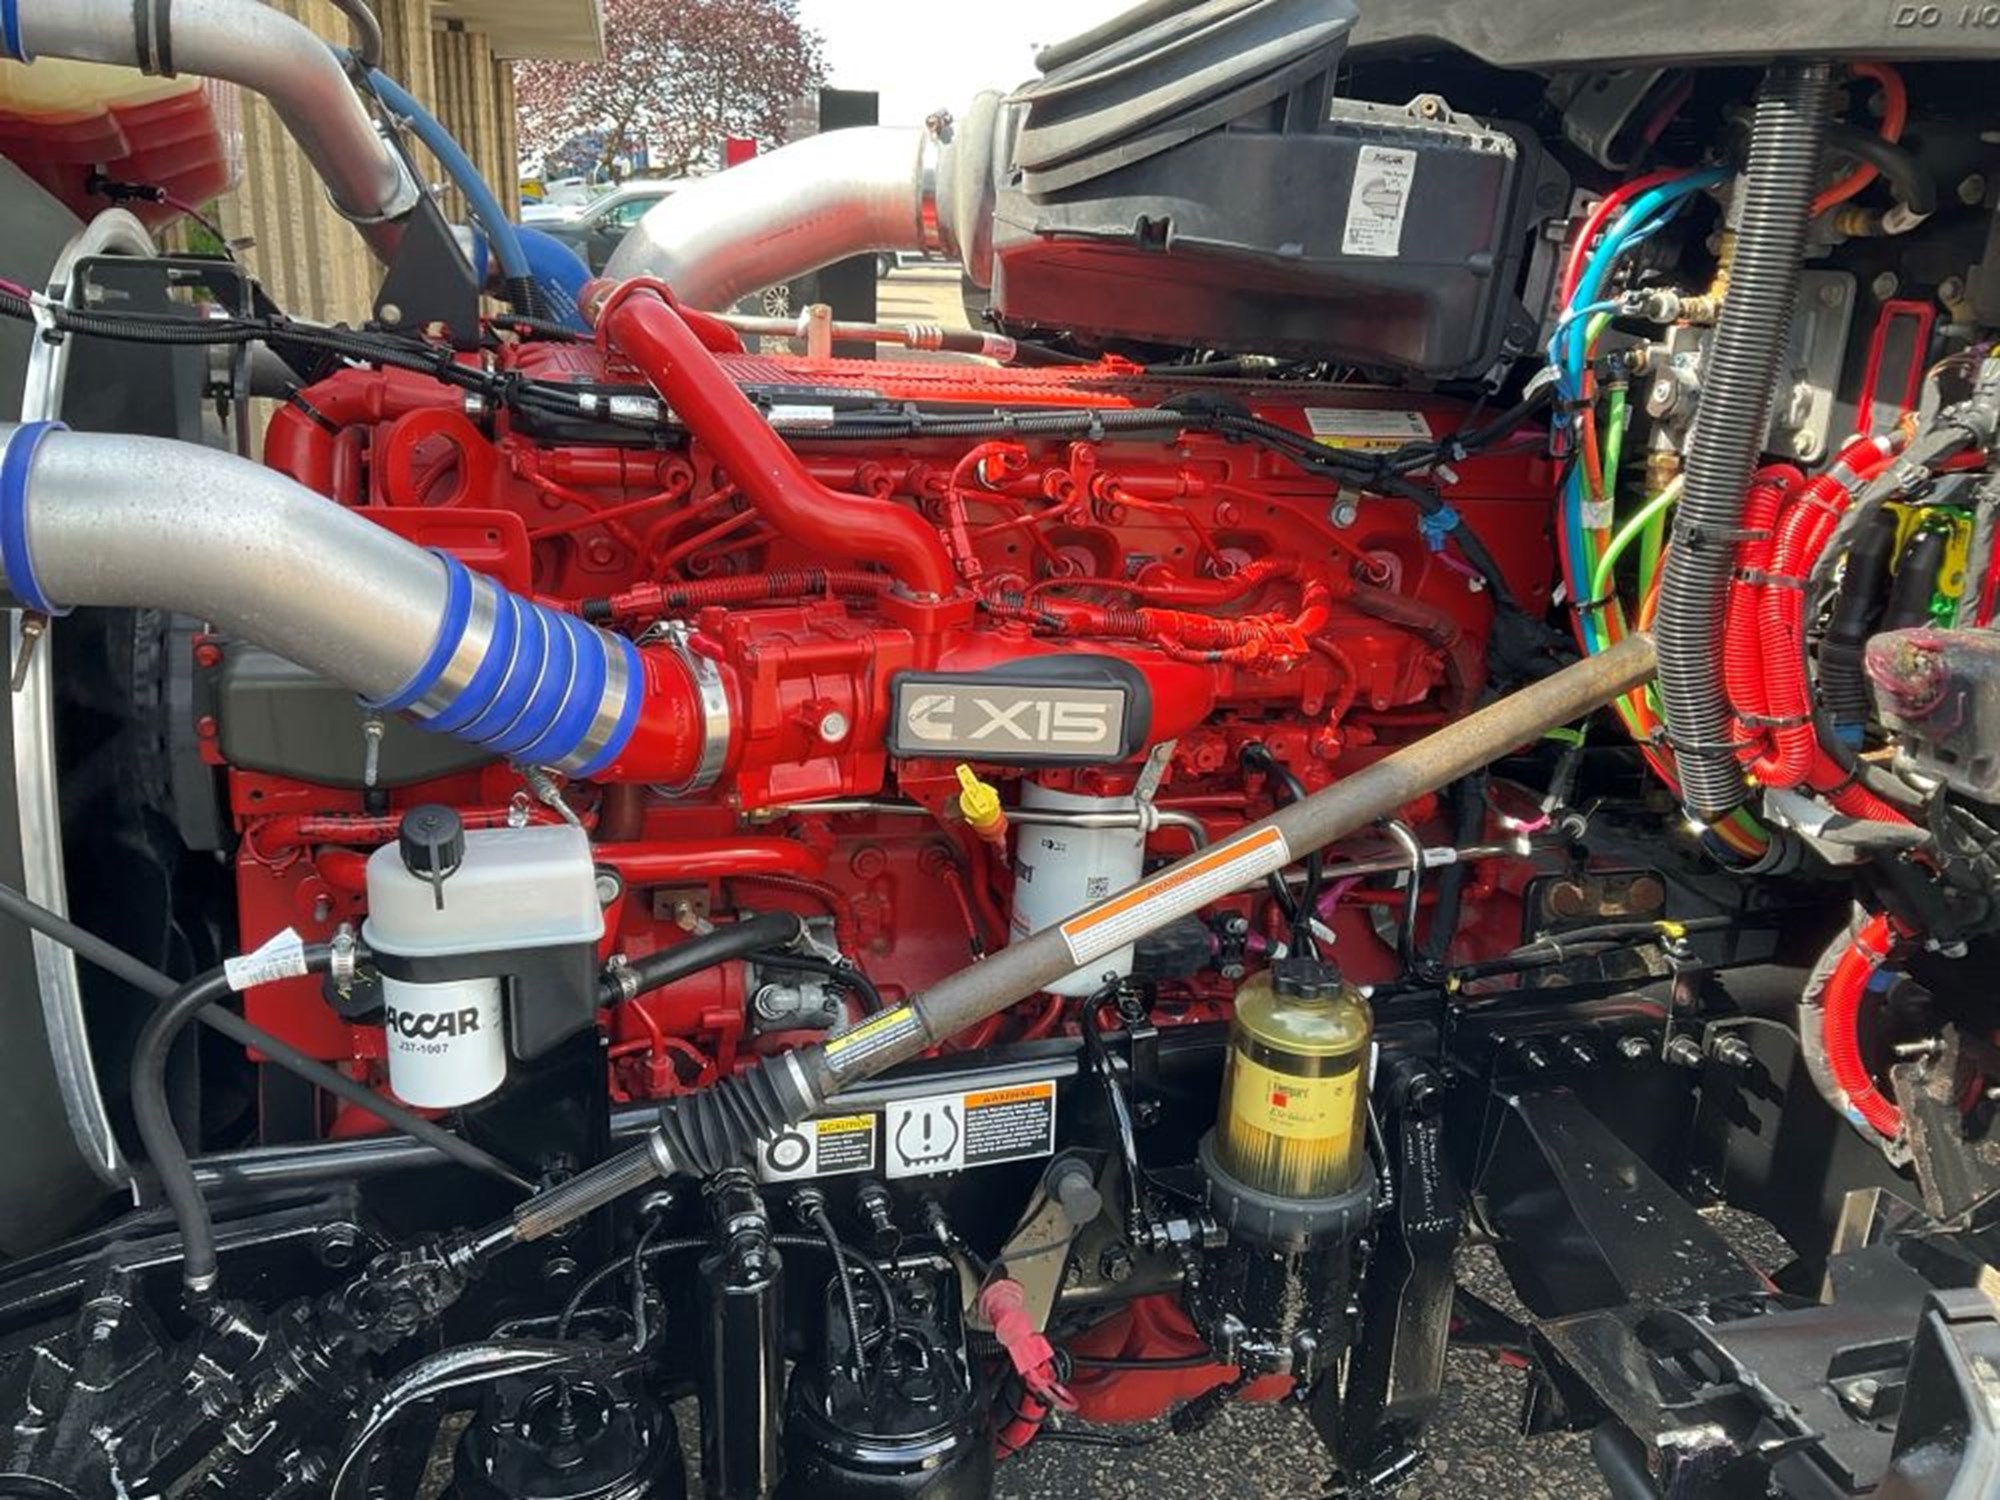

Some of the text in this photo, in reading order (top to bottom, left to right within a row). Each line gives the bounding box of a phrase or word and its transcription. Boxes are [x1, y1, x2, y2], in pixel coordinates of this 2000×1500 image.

[1893, 7, 1940, 28] DO
[968, 698, 1108, 742] X15
[387, 1005, 480, 1040] ACCAR
